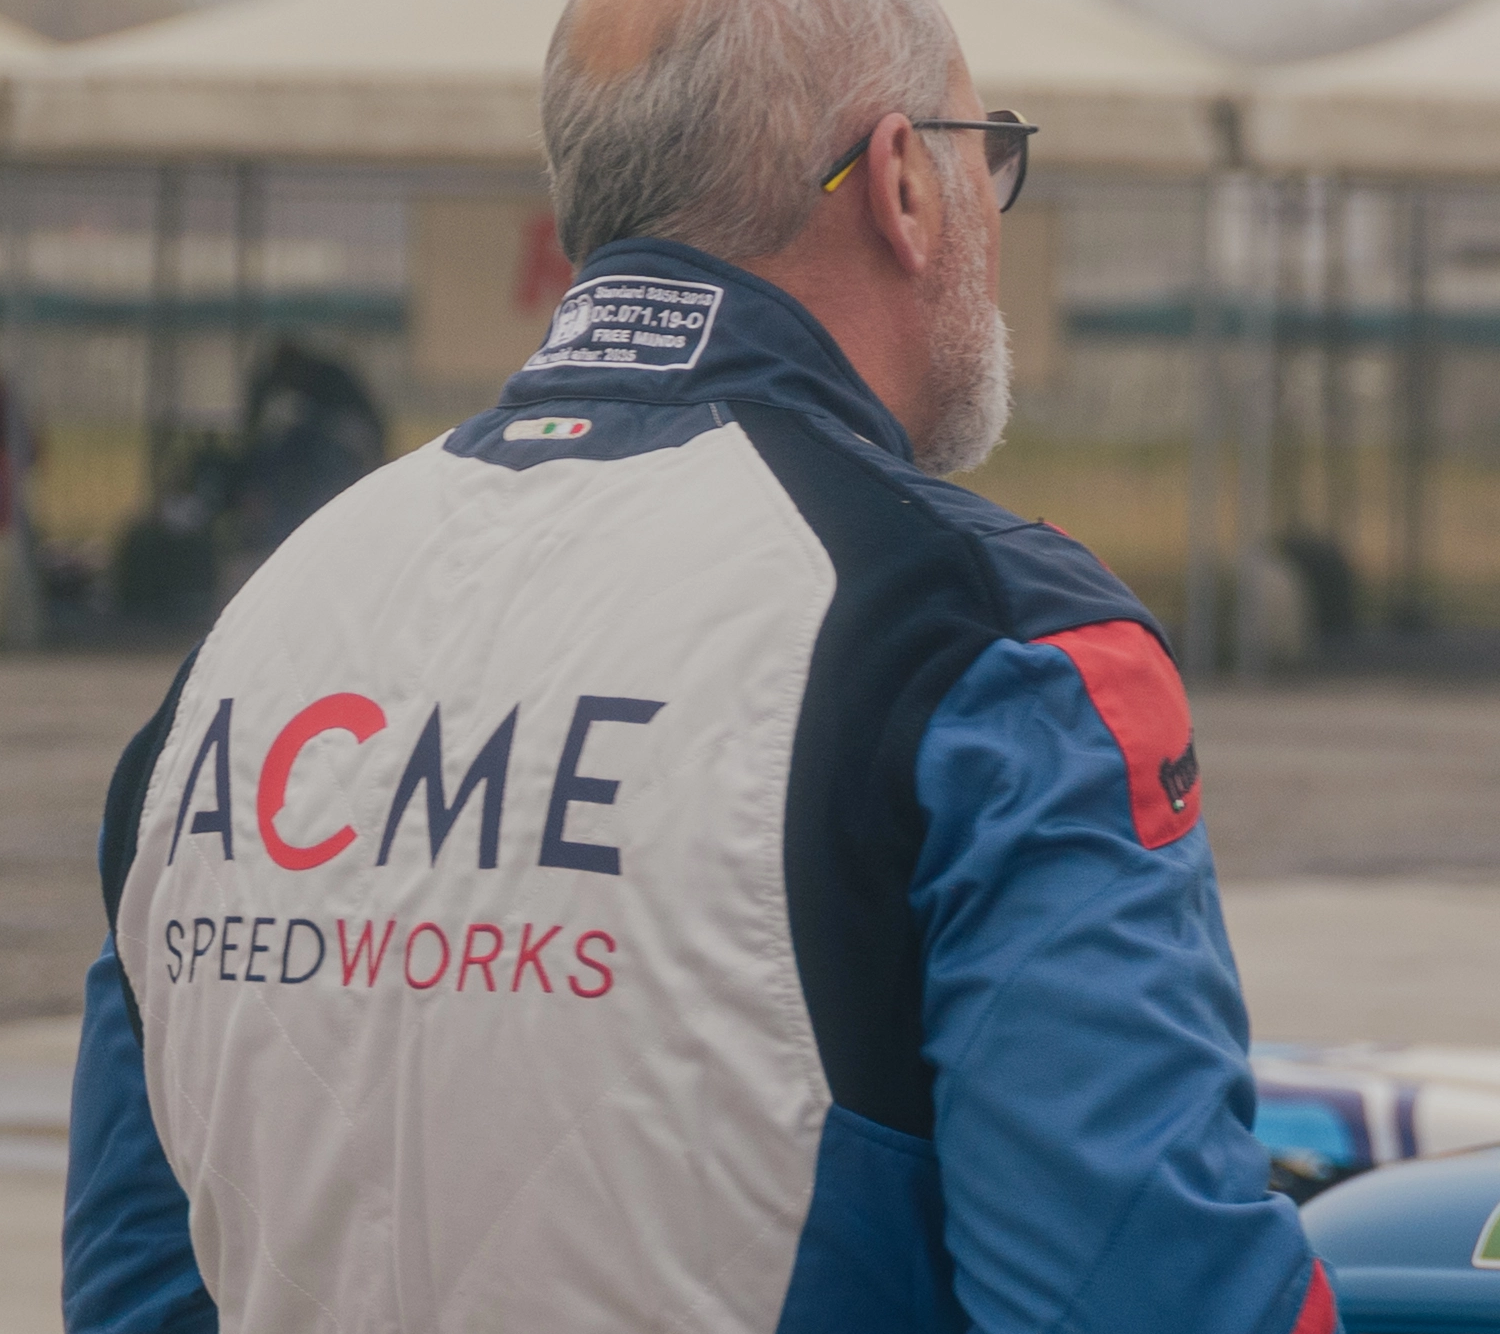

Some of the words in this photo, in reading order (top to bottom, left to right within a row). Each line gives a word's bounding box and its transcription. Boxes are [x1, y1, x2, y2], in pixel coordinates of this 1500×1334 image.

[591, 328, 631, 343] FREE
[631, 330, 687, 348] MINDS
[167, 692, 668, 875] ACME
[165, 916, 618, 999] SPEEDWORKS
